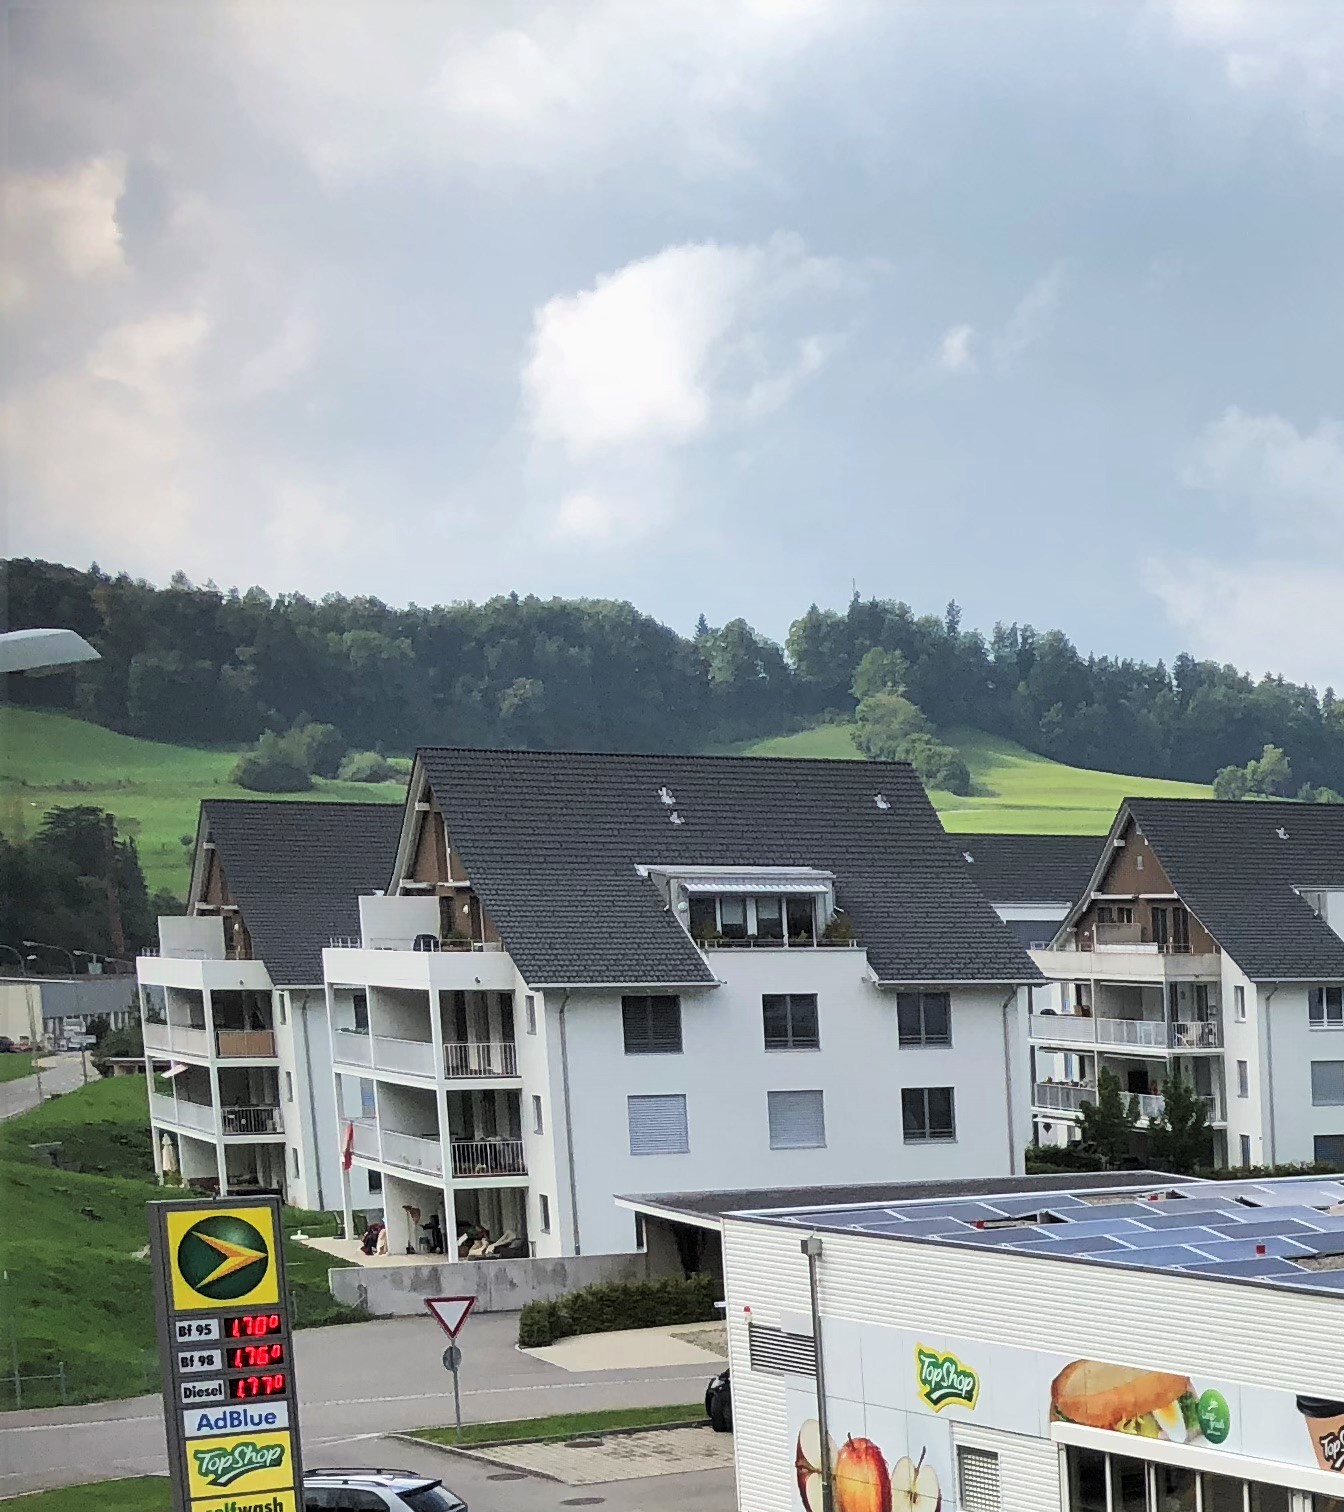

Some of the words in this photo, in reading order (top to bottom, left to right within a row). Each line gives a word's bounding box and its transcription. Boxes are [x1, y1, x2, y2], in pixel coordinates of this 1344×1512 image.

[178, 1324, 192, 1338] Bf
[195, 1323, 213, 1336] 95
[181, 1355, 194, 1368] Bf
[198, 1354, 215, 1367] 98
[920, 1354, 974, 1397] TopShop
[183, 1383, 223, 1399] Diesel
[196, 1408, 278, 1431] AdBlue
[196, 1445, 281, 1475] TopShop
